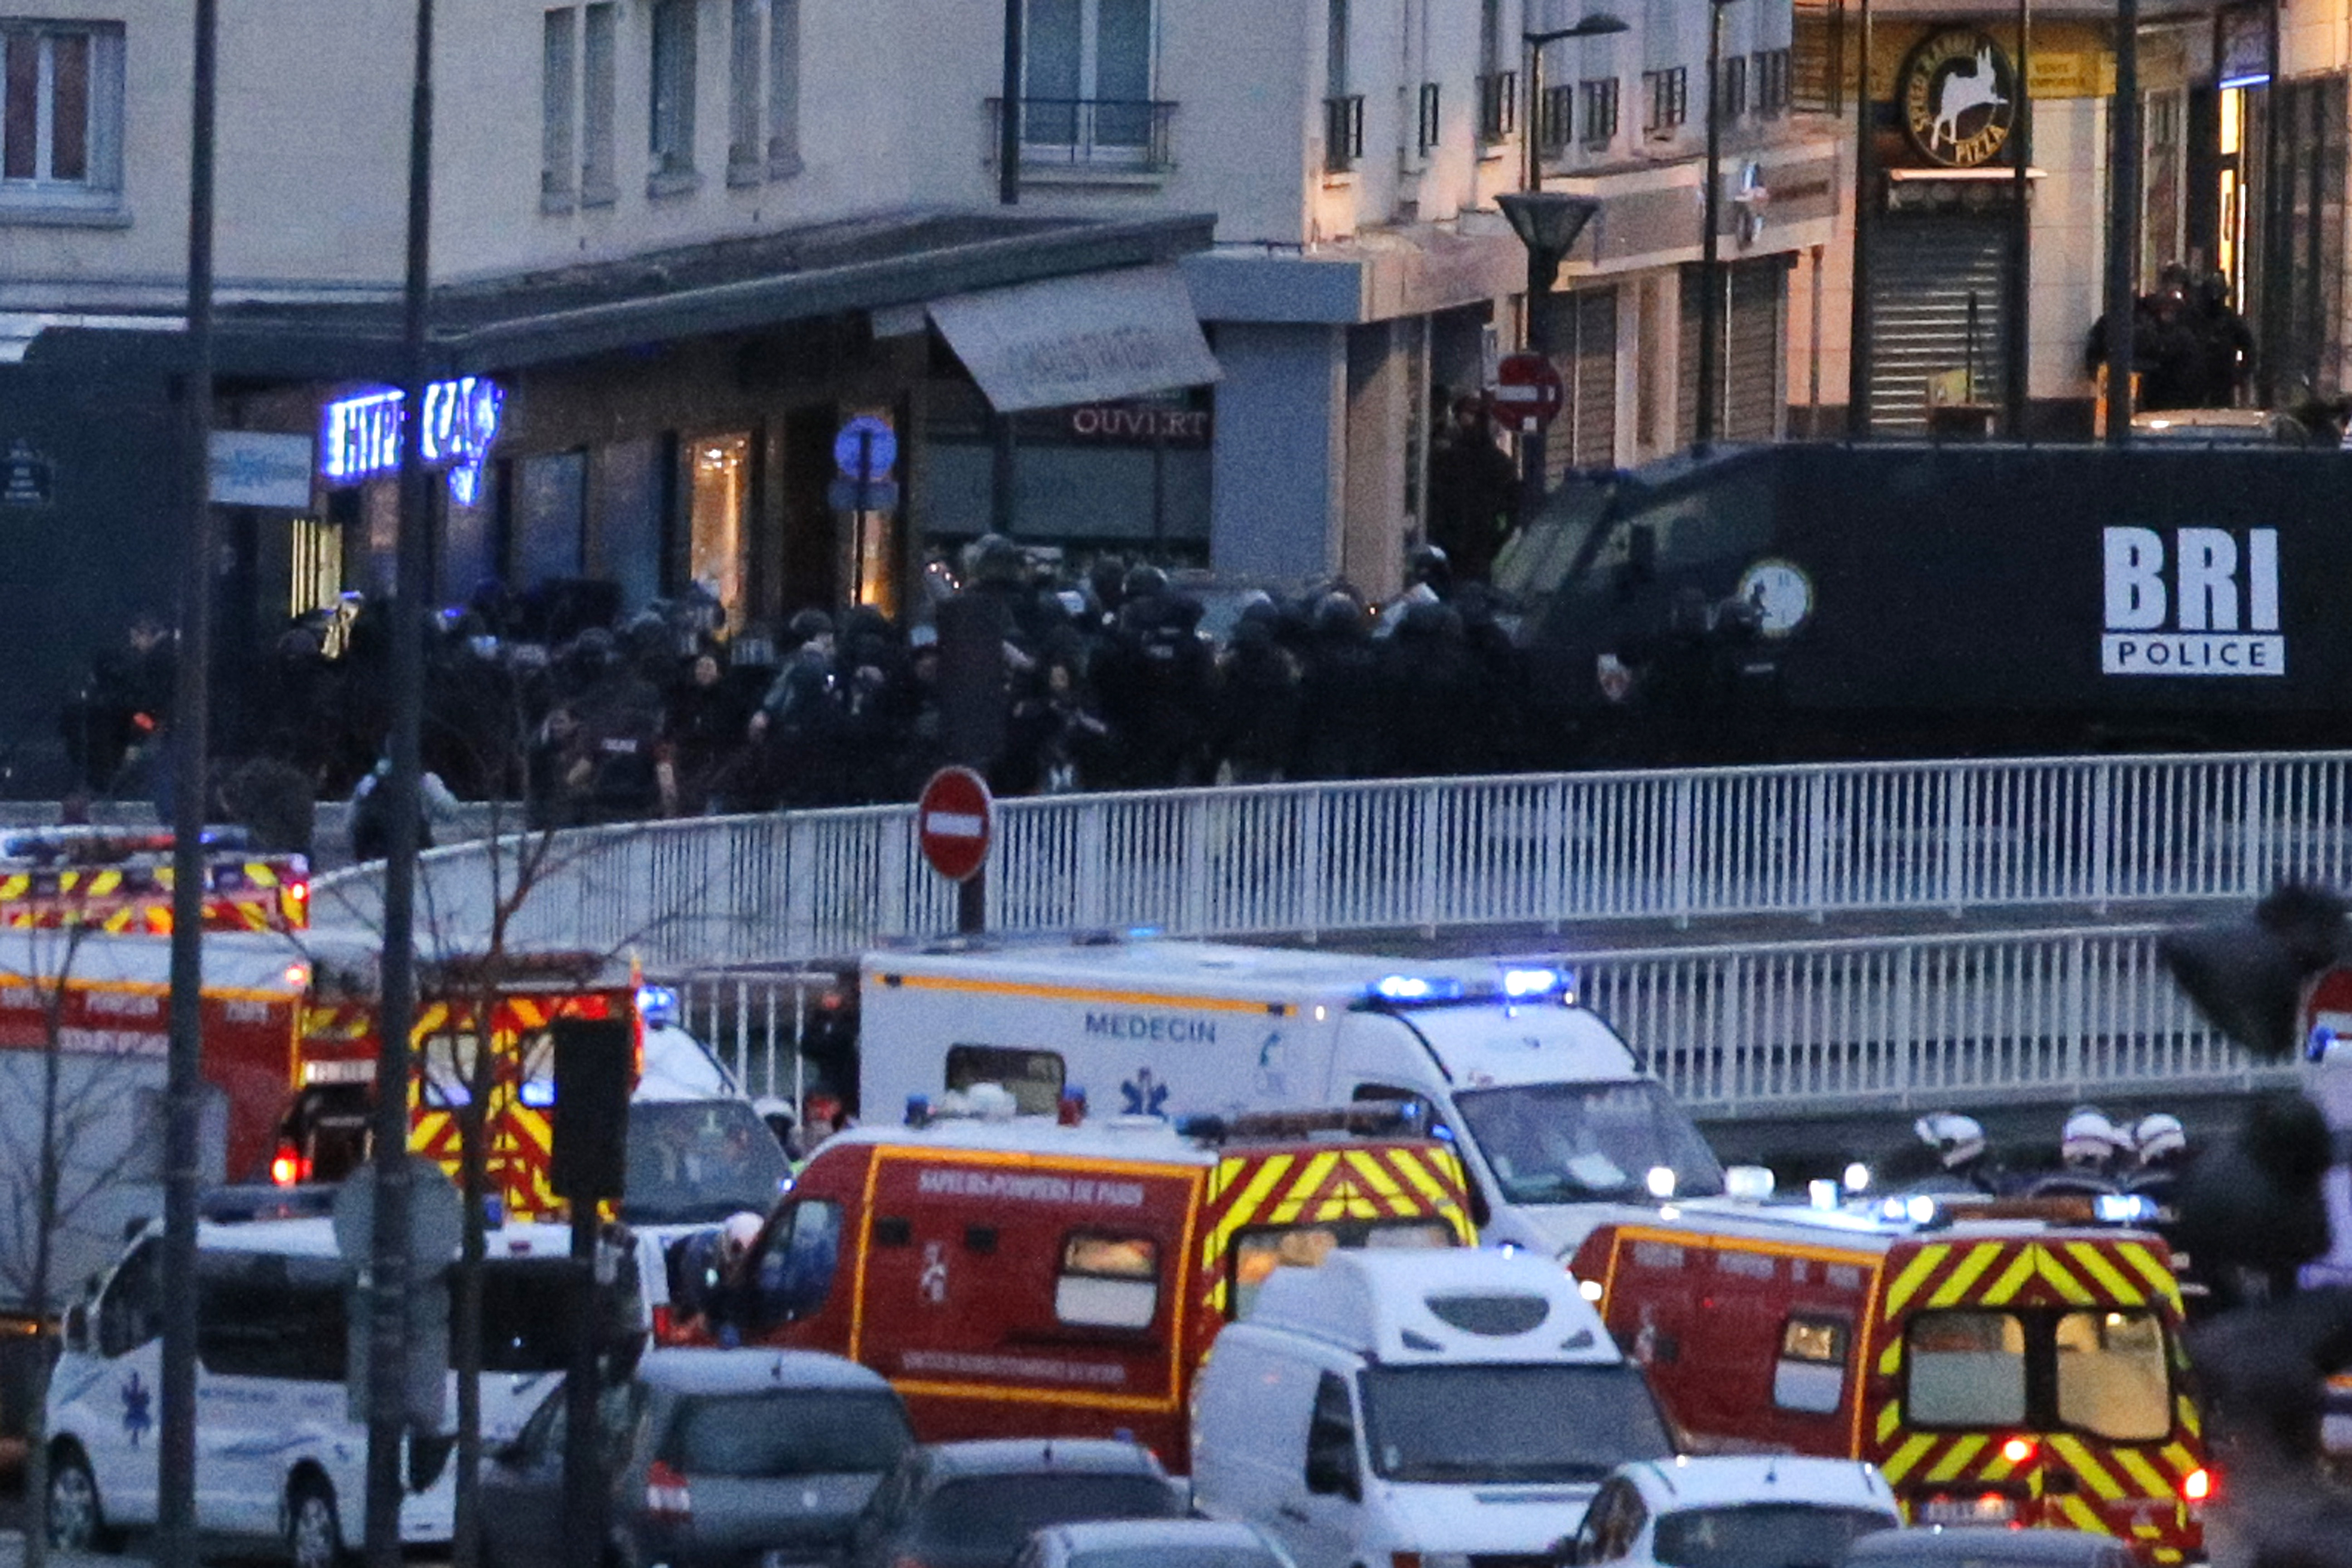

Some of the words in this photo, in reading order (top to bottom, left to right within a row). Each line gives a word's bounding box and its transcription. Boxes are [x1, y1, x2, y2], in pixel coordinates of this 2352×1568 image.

[1954, 124, 2007, 164] PIZZA
[2103, 526, 2279, 631] BRI
[2118, 642, 2266, 666] POLICE
[1085, 1012, 1215, 1044] MEDECIN
